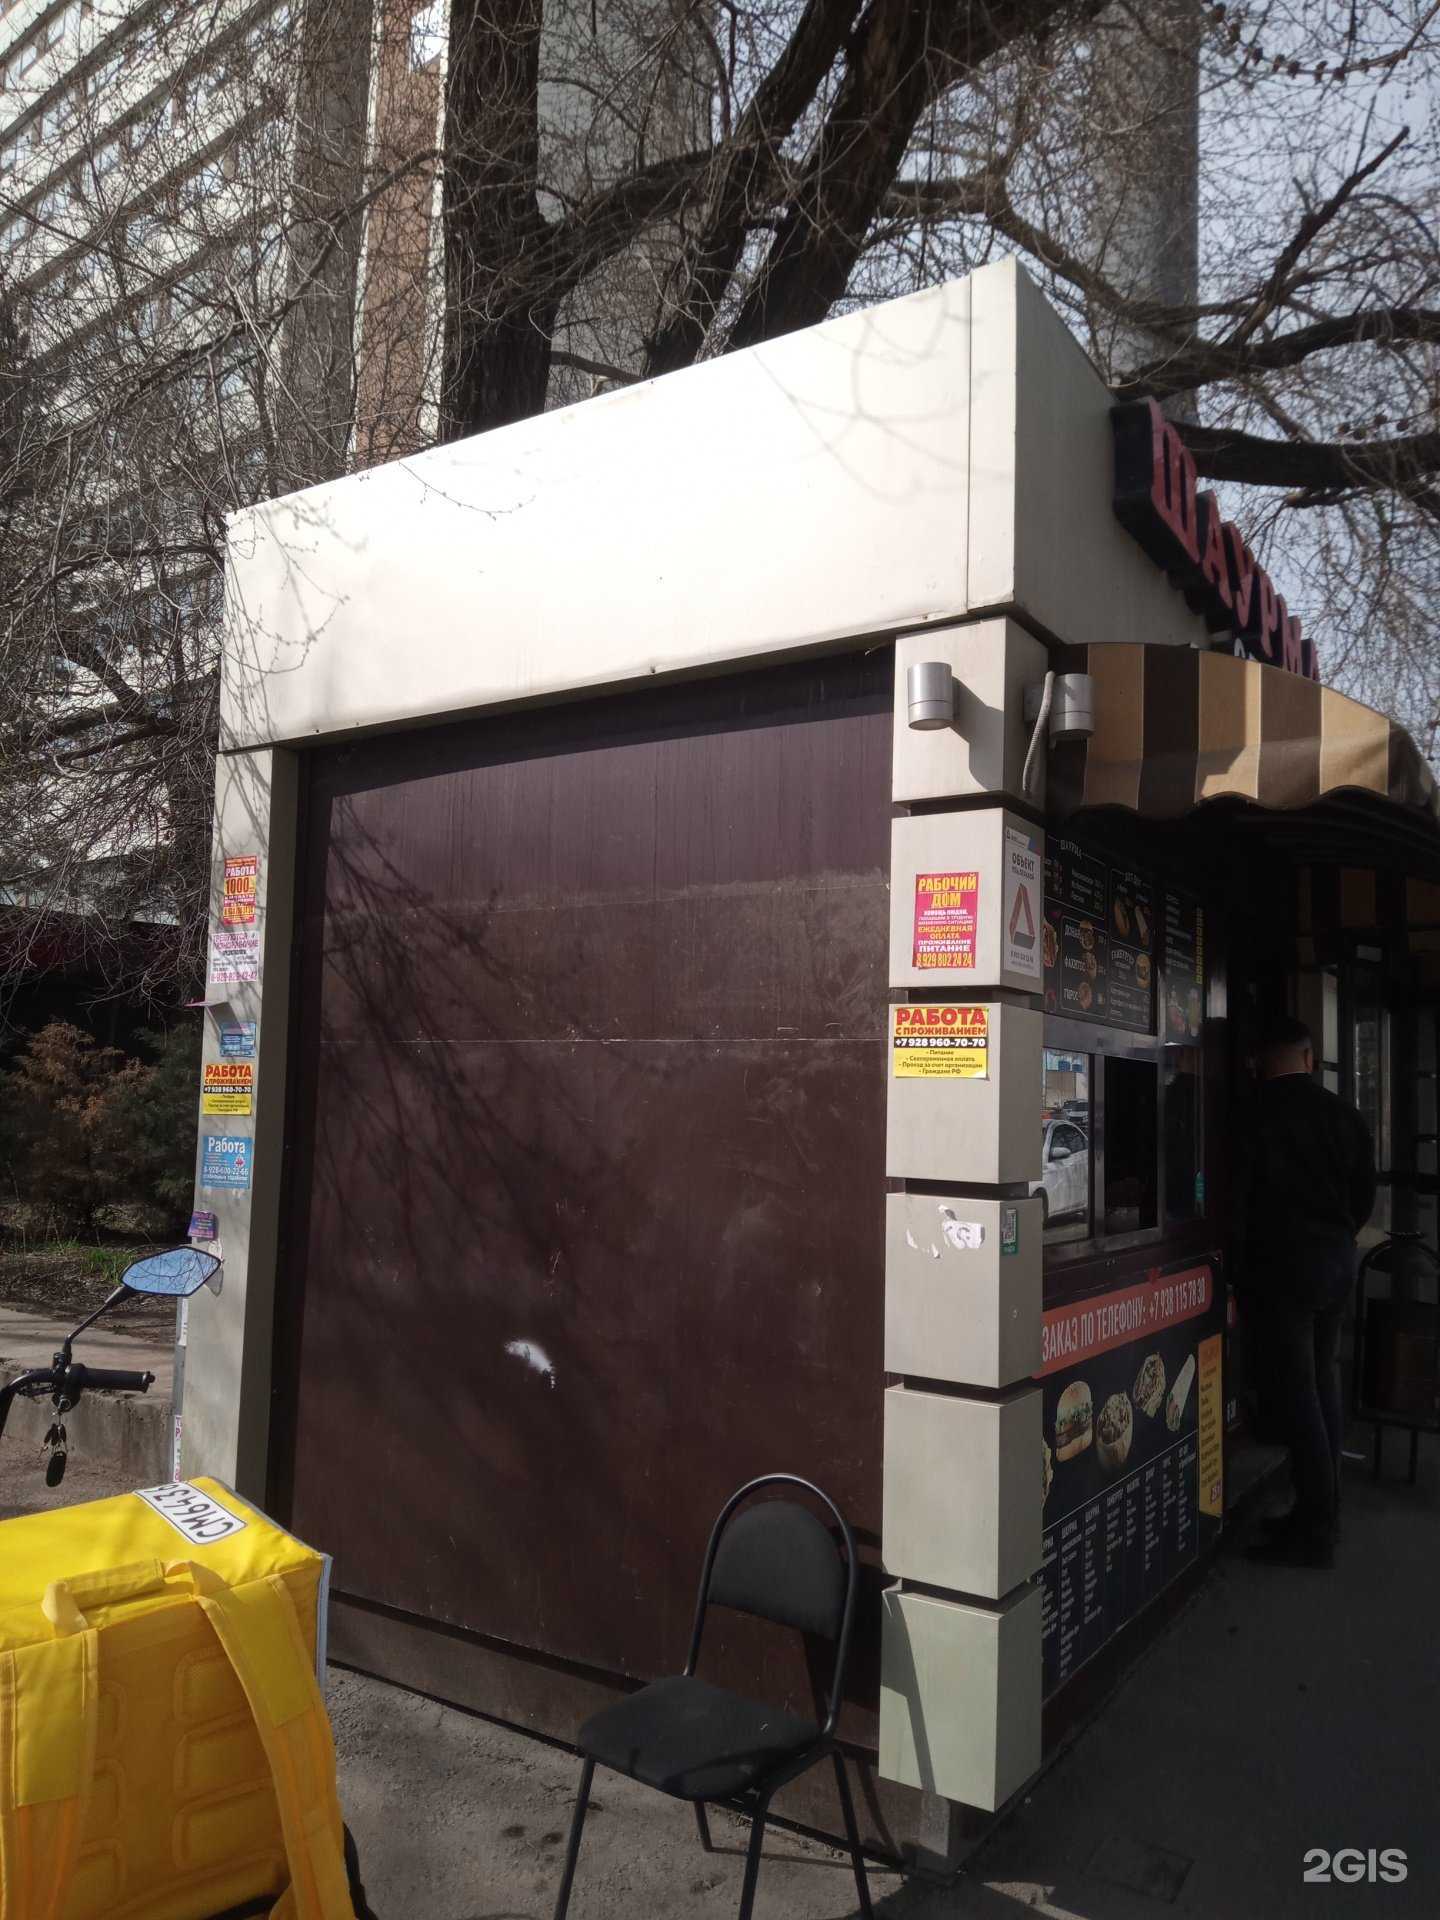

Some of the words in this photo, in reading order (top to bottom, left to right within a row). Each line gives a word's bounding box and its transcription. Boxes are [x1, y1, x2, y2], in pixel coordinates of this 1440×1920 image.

[1151, 396, 1320, 682] ШАУРМА
[1012, 852, 1034, 872] ОБЪЕКТ
[226, 866, 255, 876] РАБОТА
[226, 878, 249, 894] 1000
[918, 874, 976, 892] РАБОЧИЙ
[932, 892, 960, 908] ДОМ
[896, 1008, 986, 1025] РАБОТА
[929, 1038, 985, 1046] 960-70-70
[206, 1064, 252, 1077] РАБОТА
[208, 1137, 245, 1154] Работа
[1042, 1317, 1078, 1362] ЗАКАЗ
[1081, 1313, 1094, 1346] ПО
[1097, 1296, 1146, 1342] ТЕЛЕФОНУ:
